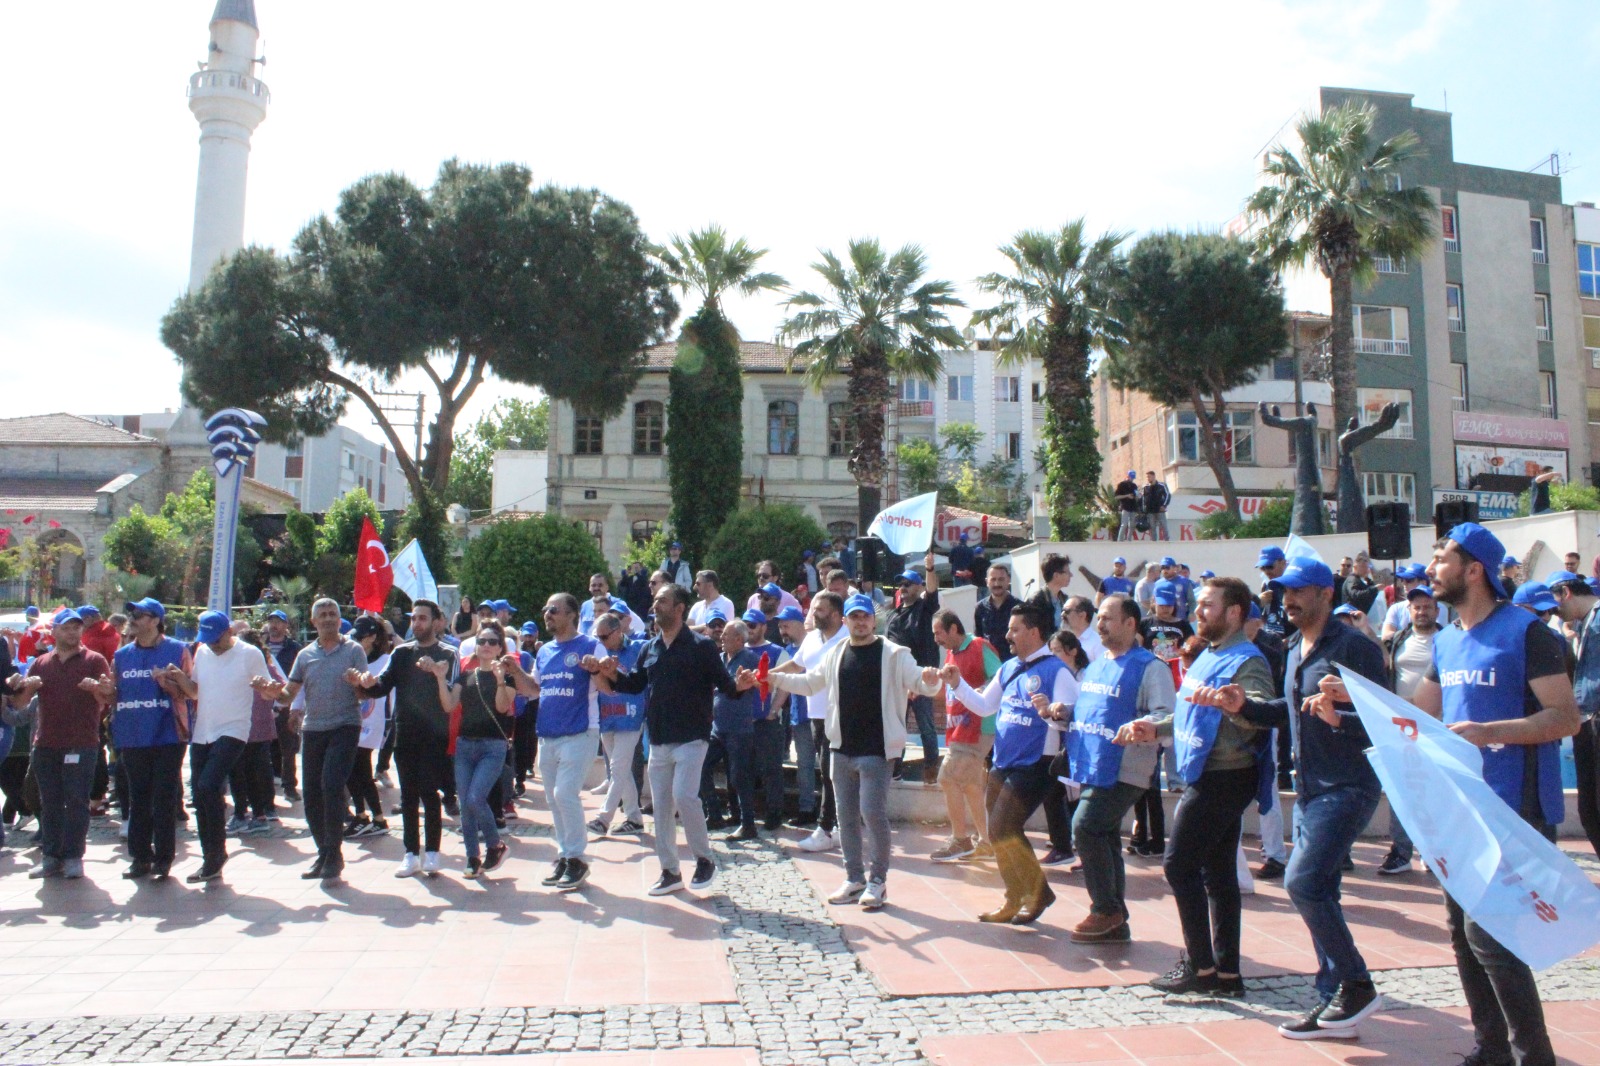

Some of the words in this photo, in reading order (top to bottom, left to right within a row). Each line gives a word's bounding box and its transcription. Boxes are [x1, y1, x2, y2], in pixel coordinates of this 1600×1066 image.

[1460, 419, 1503, 438] EMRE
[1480, 493, 1519, 510] EMR
[122, 668, 154, 679] GÖREV
[1440, 667, 1496, 688] ÖREVLİ
[540, 685, 574, 697] ENDİKASI
[1081, 681, 1121, 698] GÖREVLİ
[116, 699, 170, 711] petrol-iş
